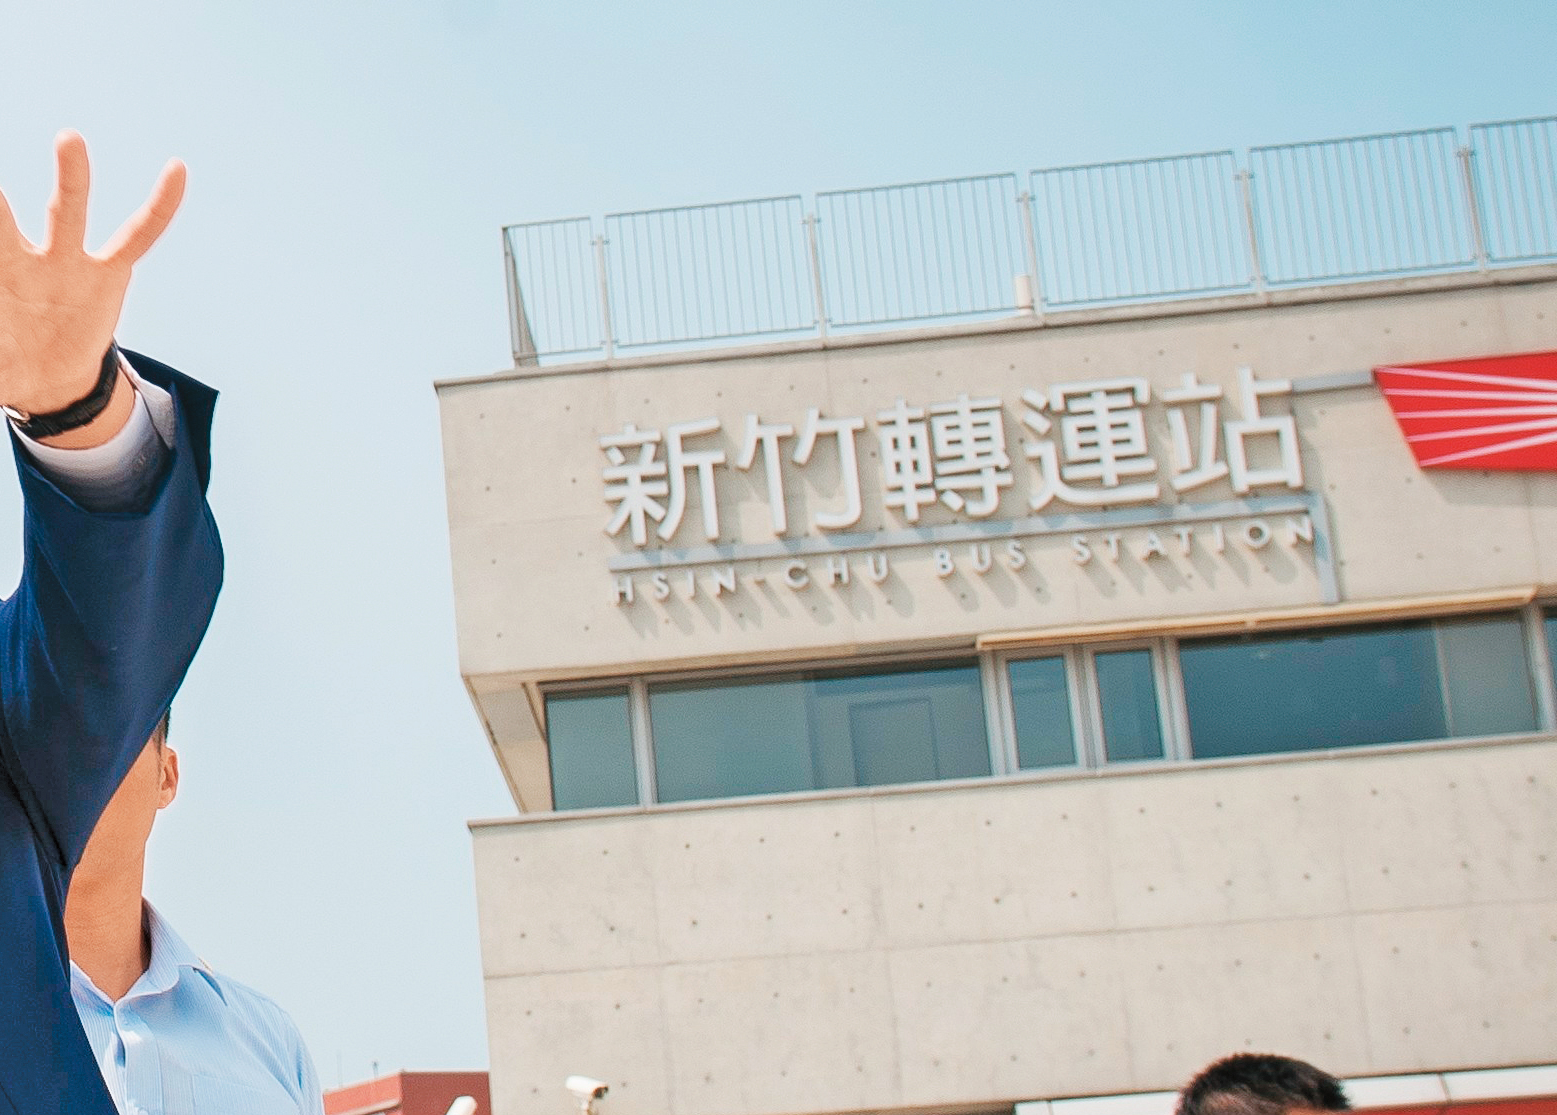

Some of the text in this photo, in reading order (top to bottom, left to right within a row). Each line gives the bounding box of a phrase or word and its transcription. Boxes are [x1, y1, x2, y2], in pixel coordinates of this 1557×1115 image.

[599, 366, 1306, 547] 新竹轉運站
[612, 515, 1314, 605] HSIN-CHU BUS STATION
